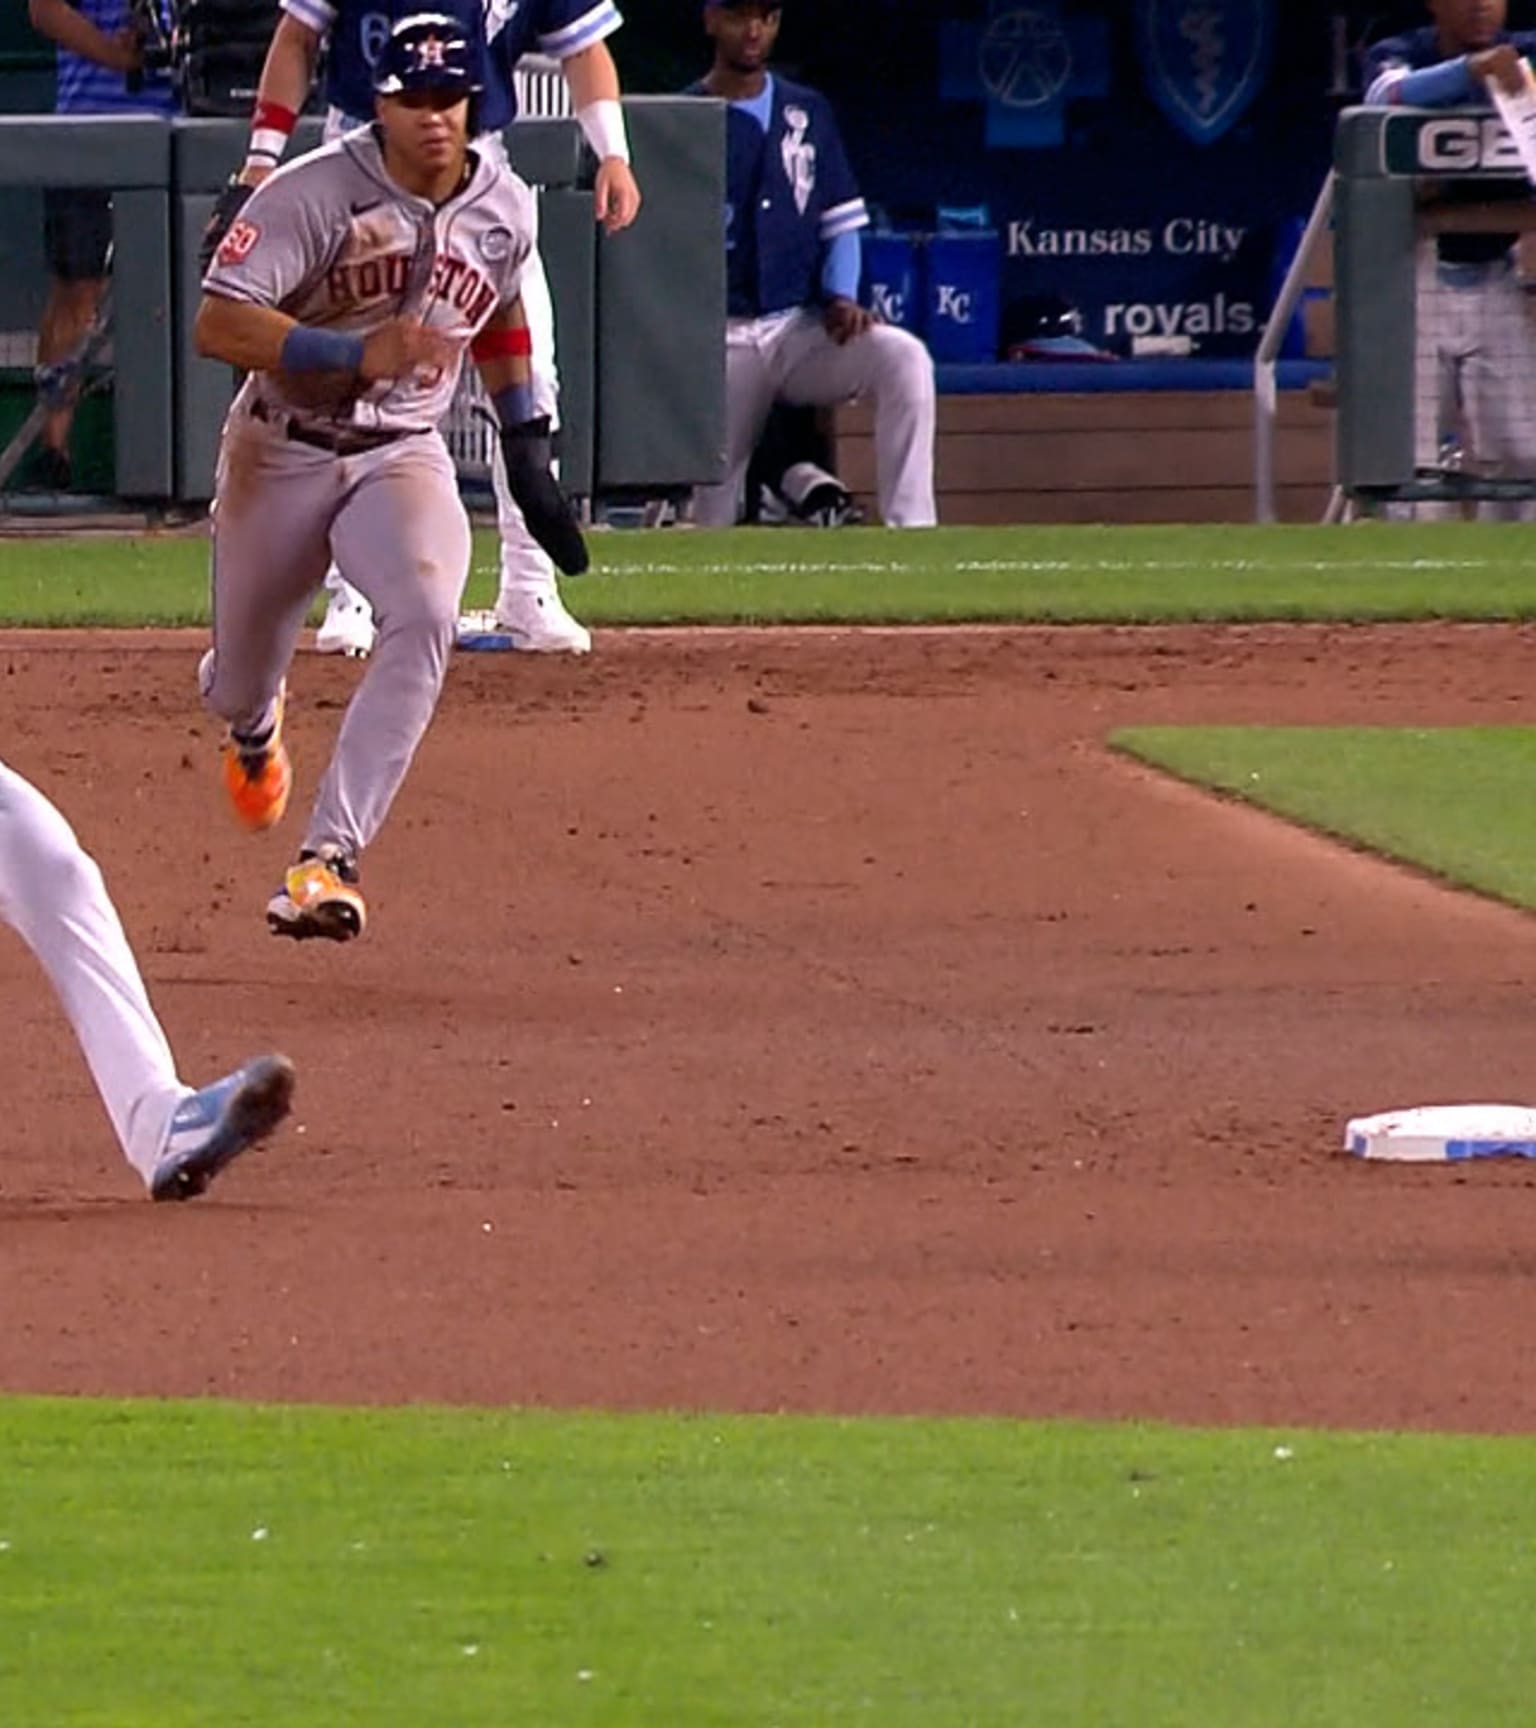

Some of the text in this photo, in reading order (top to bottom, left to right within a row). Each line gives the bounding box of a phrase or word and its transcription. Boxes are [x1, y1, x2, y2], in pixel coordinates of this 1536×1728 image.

[1007, 218, 1246, 262] Kansas City
[937, 286, 971, 323] KC
